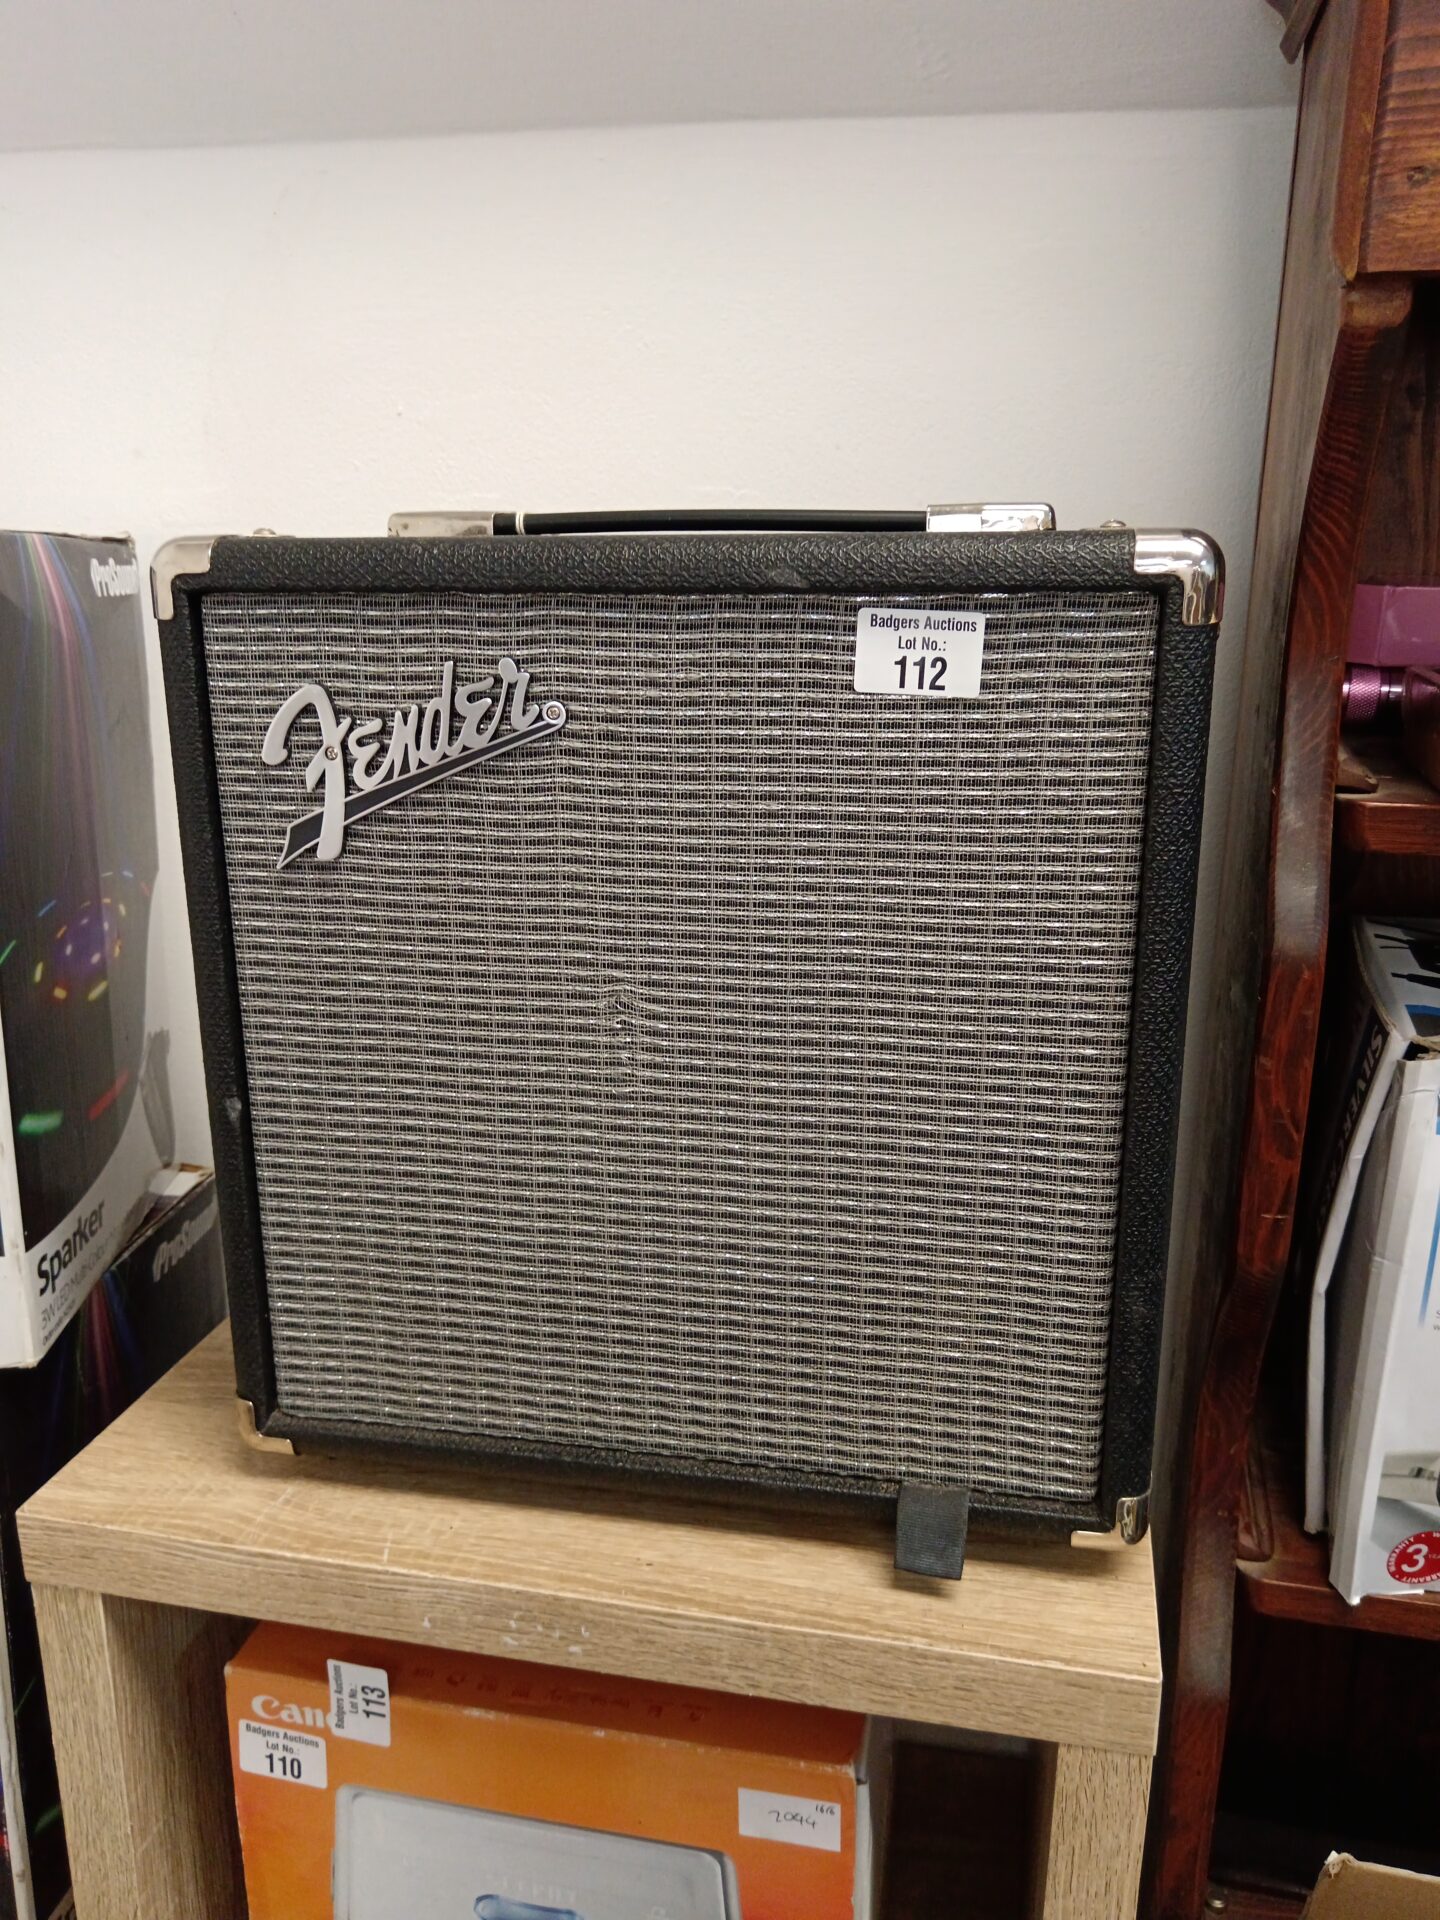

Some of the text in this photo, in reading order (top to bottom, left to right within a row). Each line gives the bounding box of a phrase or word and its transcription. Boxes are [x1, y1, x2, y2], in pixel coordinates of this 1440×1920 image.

[870, 613, 977, 632] Badgers Auctions
[898, 636, 917, 650] Lot
[894, 655, 948, 691] 112
[261, 657, 540, 861] Fender
[37, 1199, 105, 1297] Sparker
[1401, 1543, 1429, 1573] 3
[251, 1694, 332, 1729] Can
[333, 1664, 347, 1729] Badgers Auctions
[349, 1702, 359, 1714] Lot
[361, 1685, 386, 1719] 113
[245, 1723, 319, 1749] Badgers Auctions
[266, 1740, 279, 1751] Lot
[265, 1752, 302, 1780] 110
